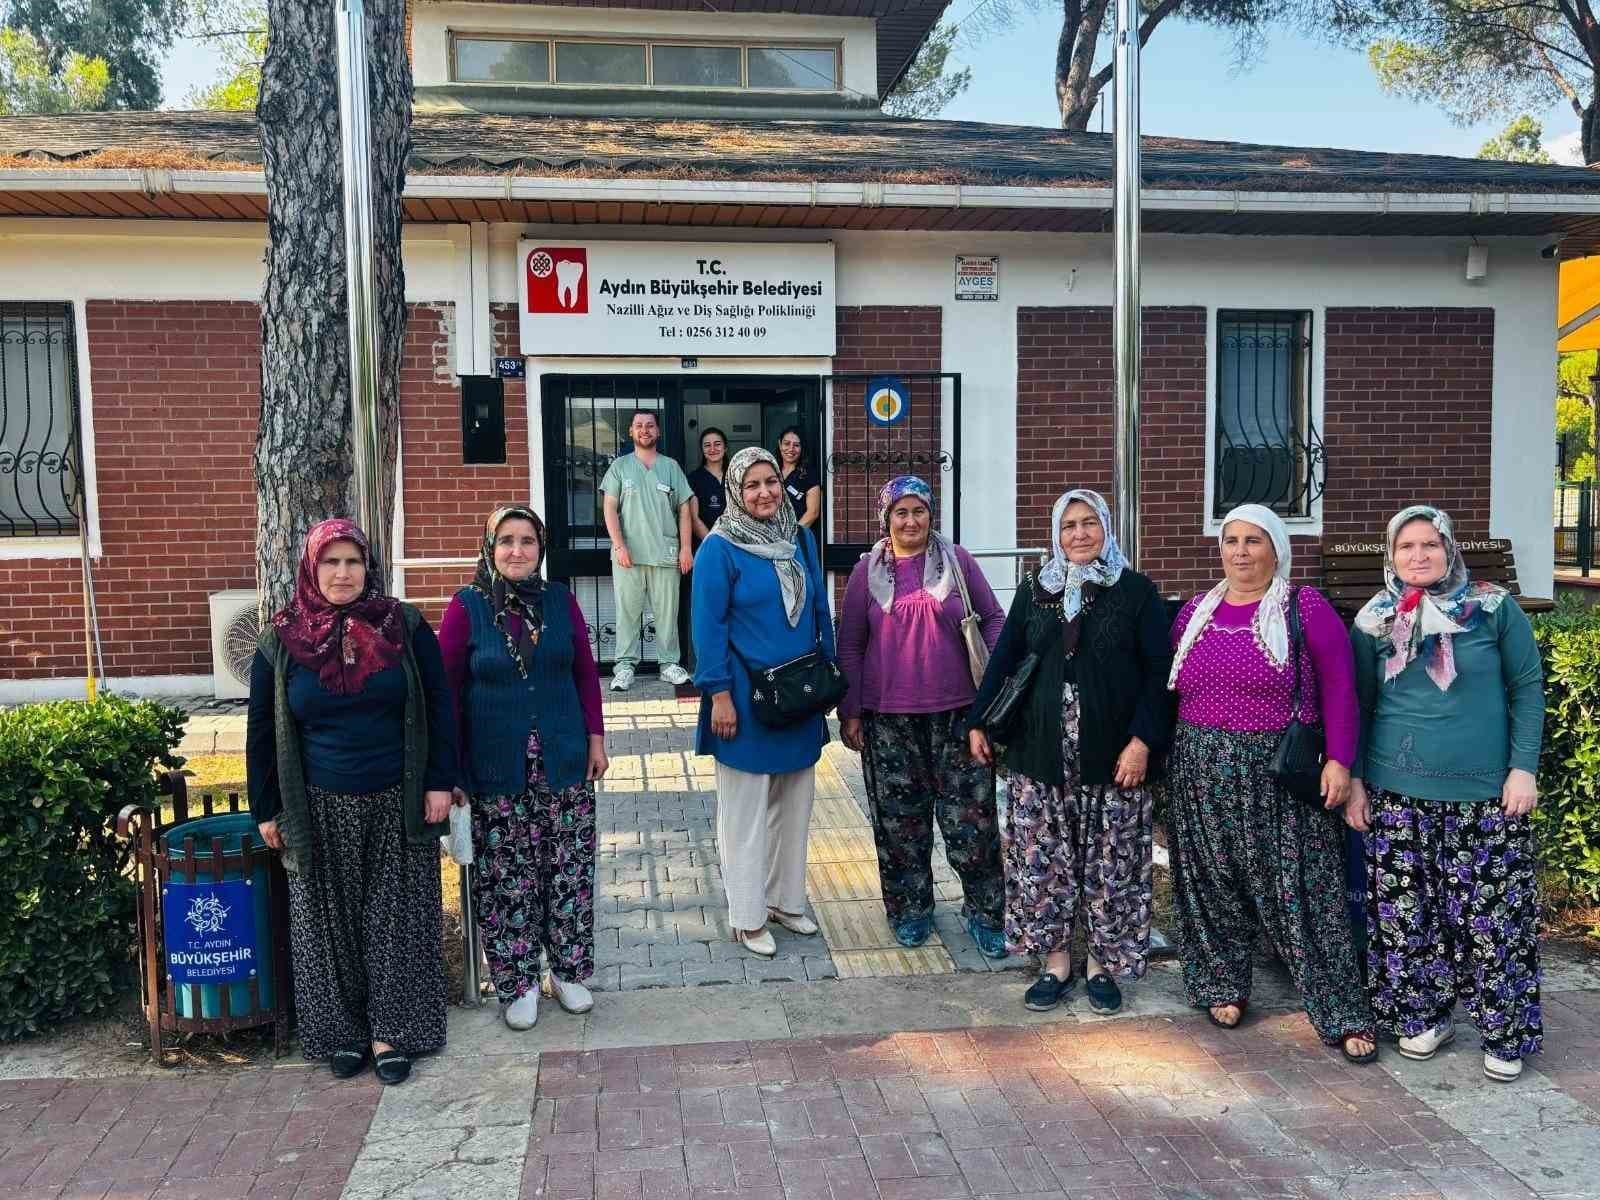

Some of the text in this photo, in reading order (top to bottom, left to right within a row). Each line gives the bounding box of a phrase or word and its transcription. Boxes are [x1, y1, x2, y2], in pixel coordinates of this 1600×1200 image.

[696, 259, 726, 275] T.C.
[959, 276, 993, 286] AYGES
[599, 279, 822, 299] Aydın Büyükşehir Belediyesi
[606, 303, 816, 319] Nazilli Ağız ve Diş Sağlığı Polikliniği
[658, 326, 676, 337] Tel
[686, 326, 712, 338] 0256
[715, 326, 734, 338] 312
[737, 326, 751, 338] 40
[753, 326, 767, 338] 09
[1335, 540, 1501, 554] BÜYÜKŞE EDİYESİ
[204, 939, 231, 950] AYDIN
[170, 947, 252, 966] BÜYÜKŞEHİR
[186, 965, 236, 977] BELEDİYESİ
